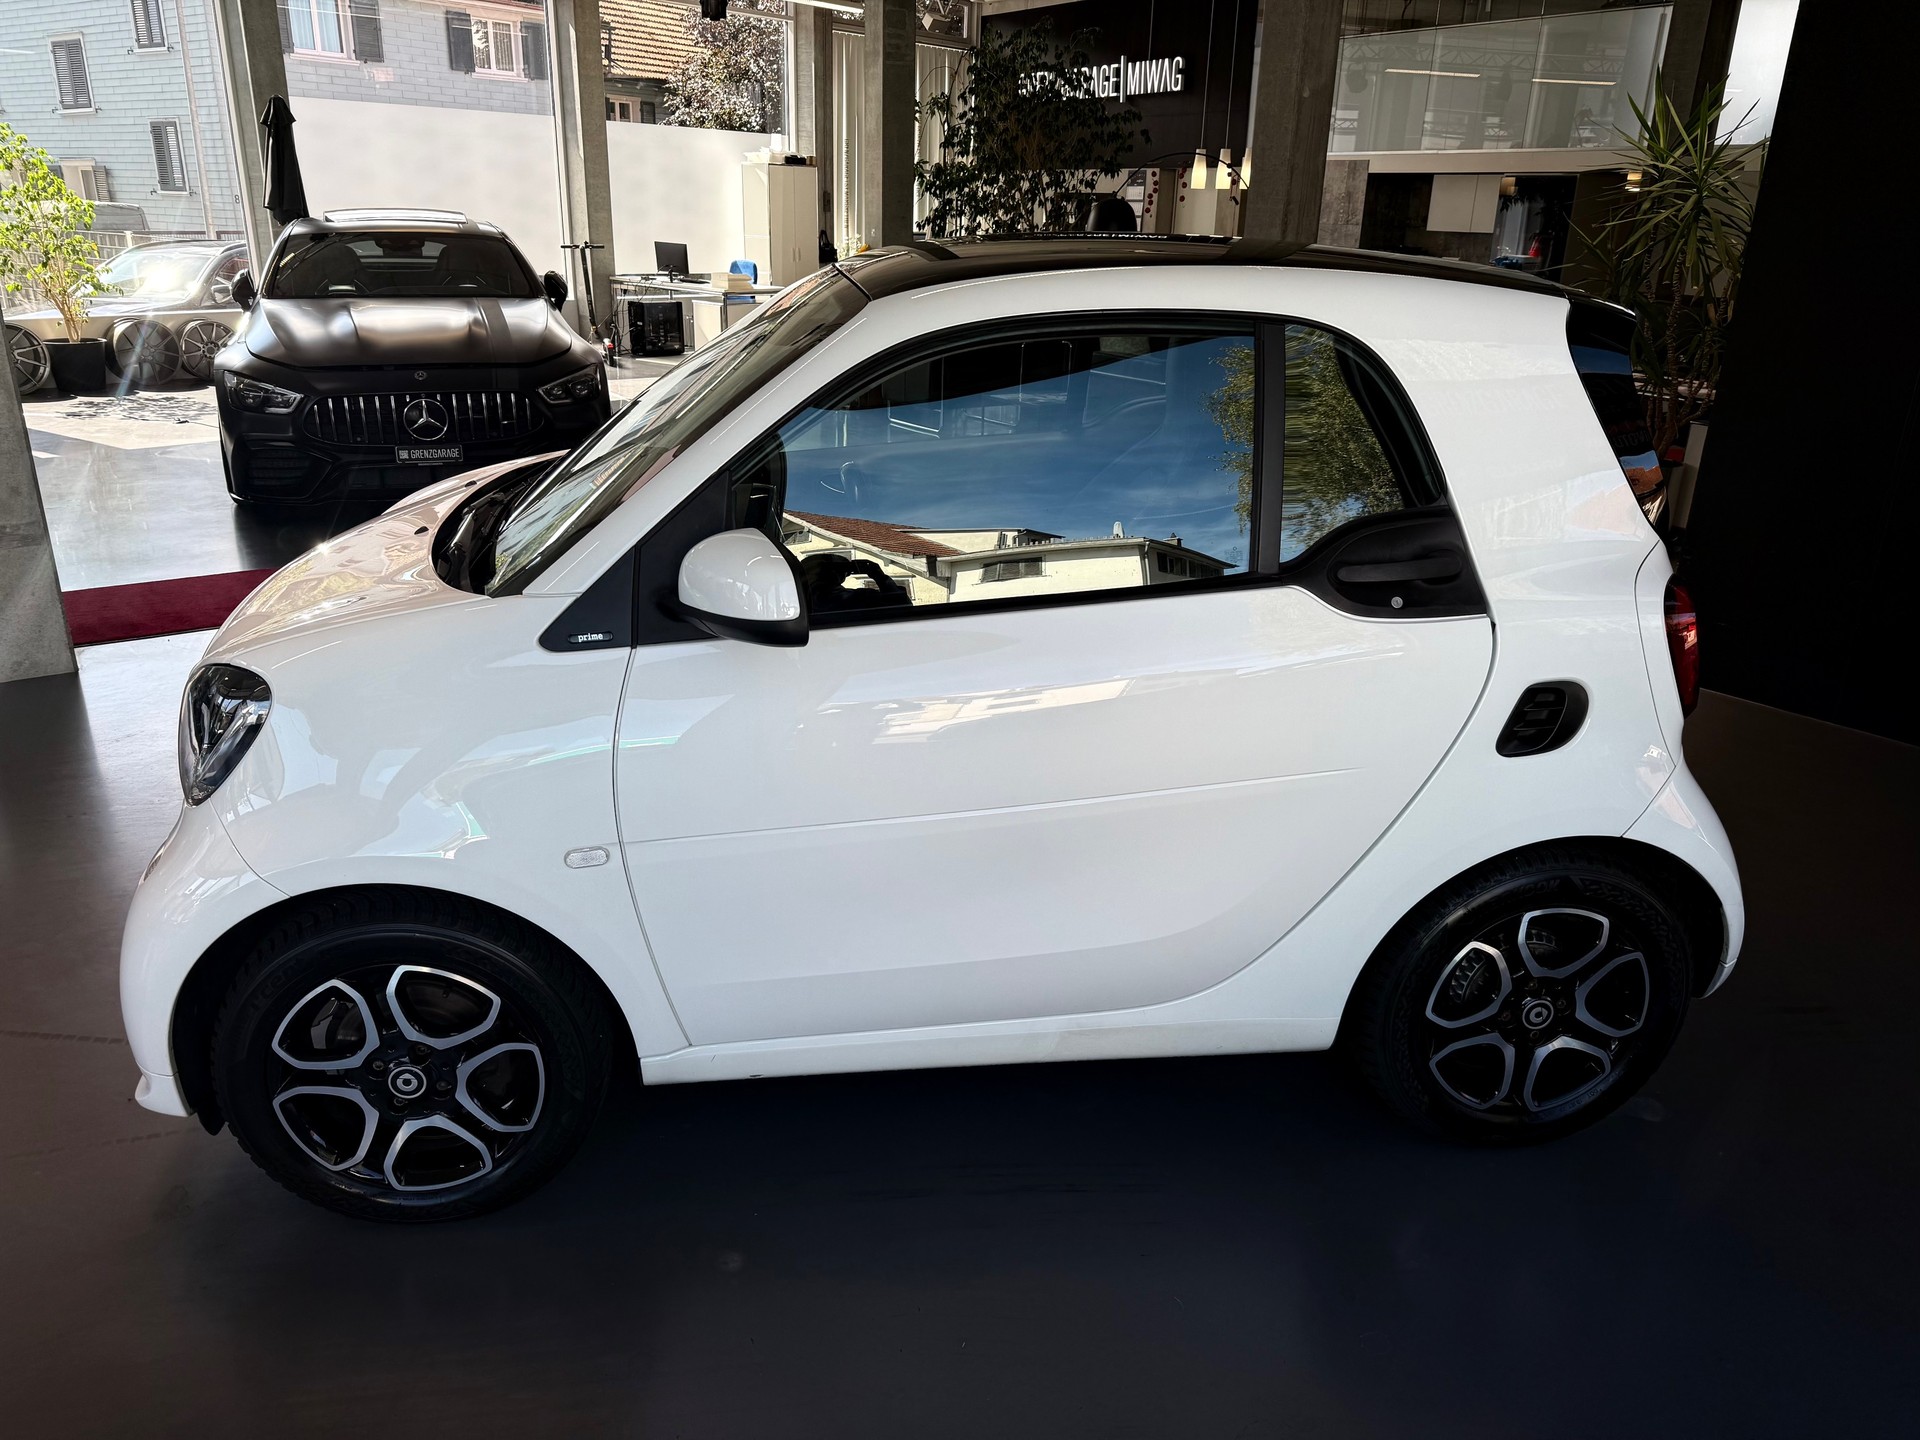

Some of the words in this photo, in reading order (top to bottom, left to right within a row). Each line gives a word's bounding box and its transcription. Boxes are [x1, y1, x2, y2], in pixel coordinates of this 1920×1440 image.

[1127, 56, 1184, 95] MIWAG
[410, 448, 460, 459] GRENZGARAGE
[578, 632, 604, 643] prime
